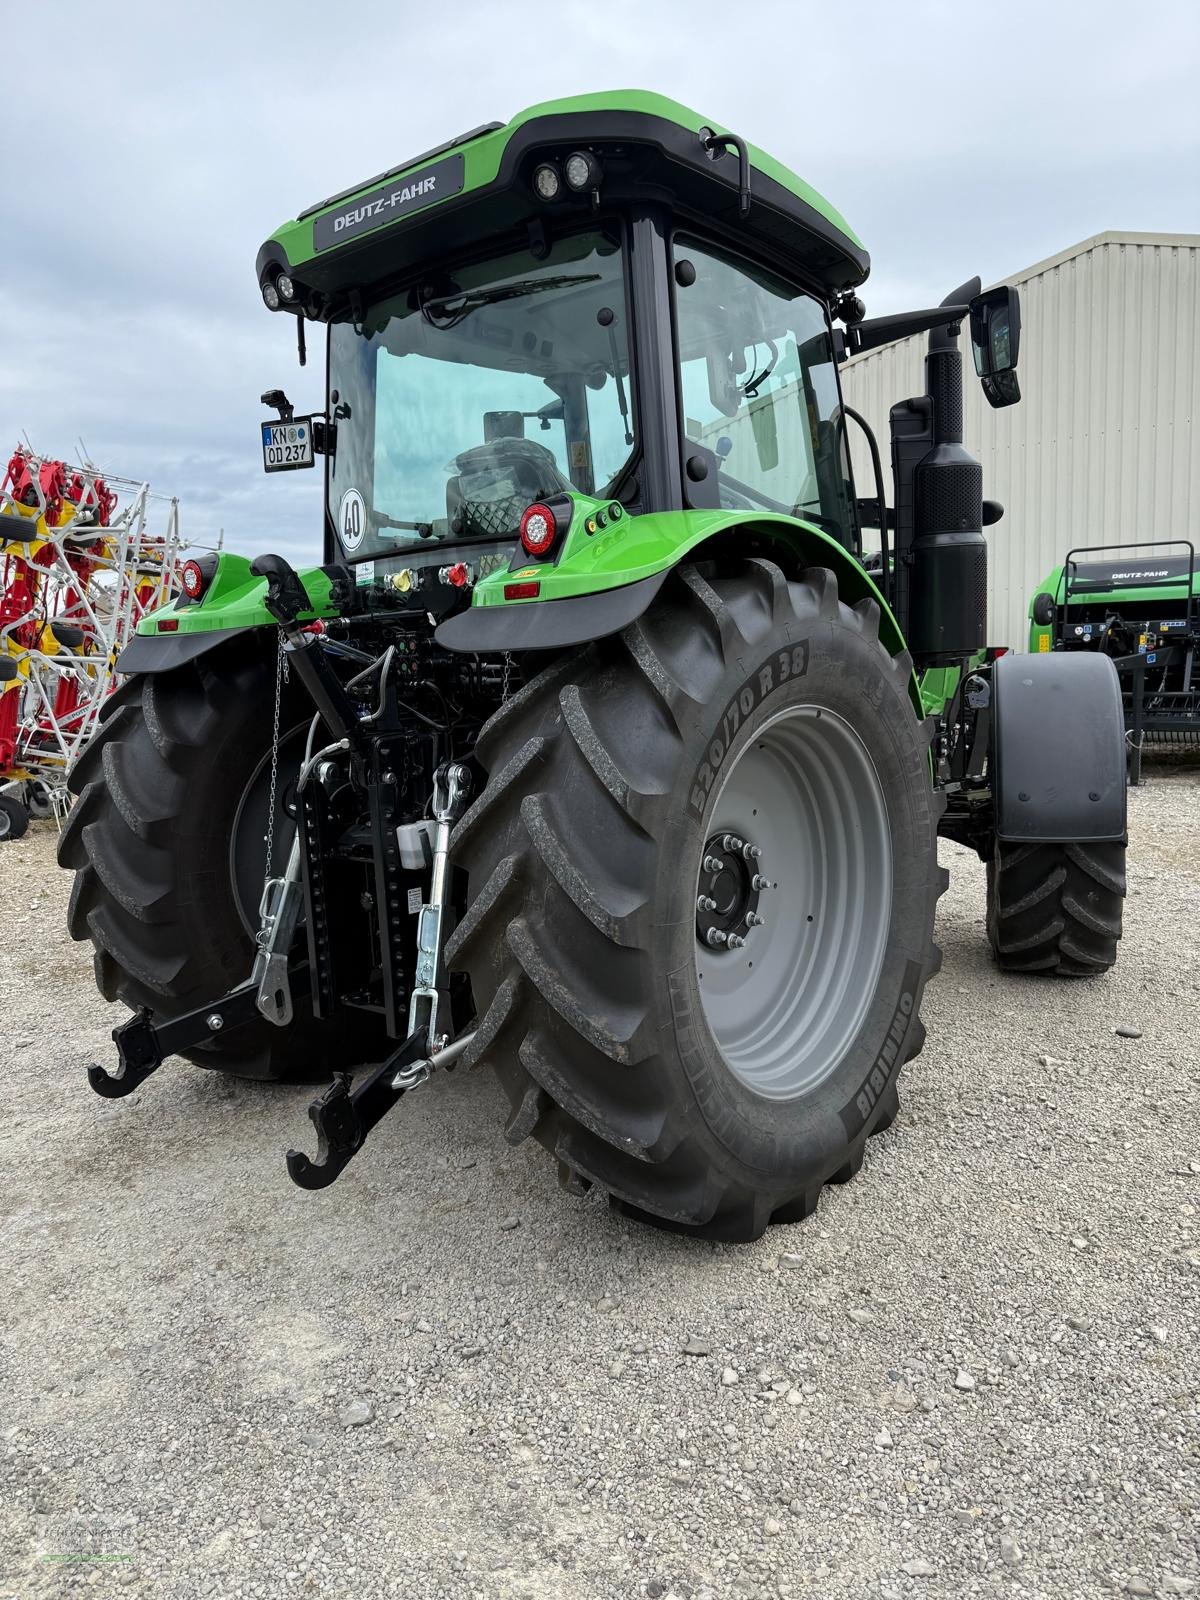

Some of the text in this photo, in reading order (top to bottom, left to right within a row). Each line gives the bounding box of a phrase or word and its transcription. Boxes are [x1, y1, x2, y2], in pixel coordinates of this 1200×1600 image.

[334, 176, 436, 232] DEUTZ-FAHR
[269, 444, 306, 463] OD 237
[272, 427, 287, 445] KN
[344, 500, 360, 539] 40
[1111, 570, 1169, 579] DEUTZ-FAHR
[690, 646, 804, 813] 520/70 R 38
[856, 991, 913, 1120] OMNIBIB
